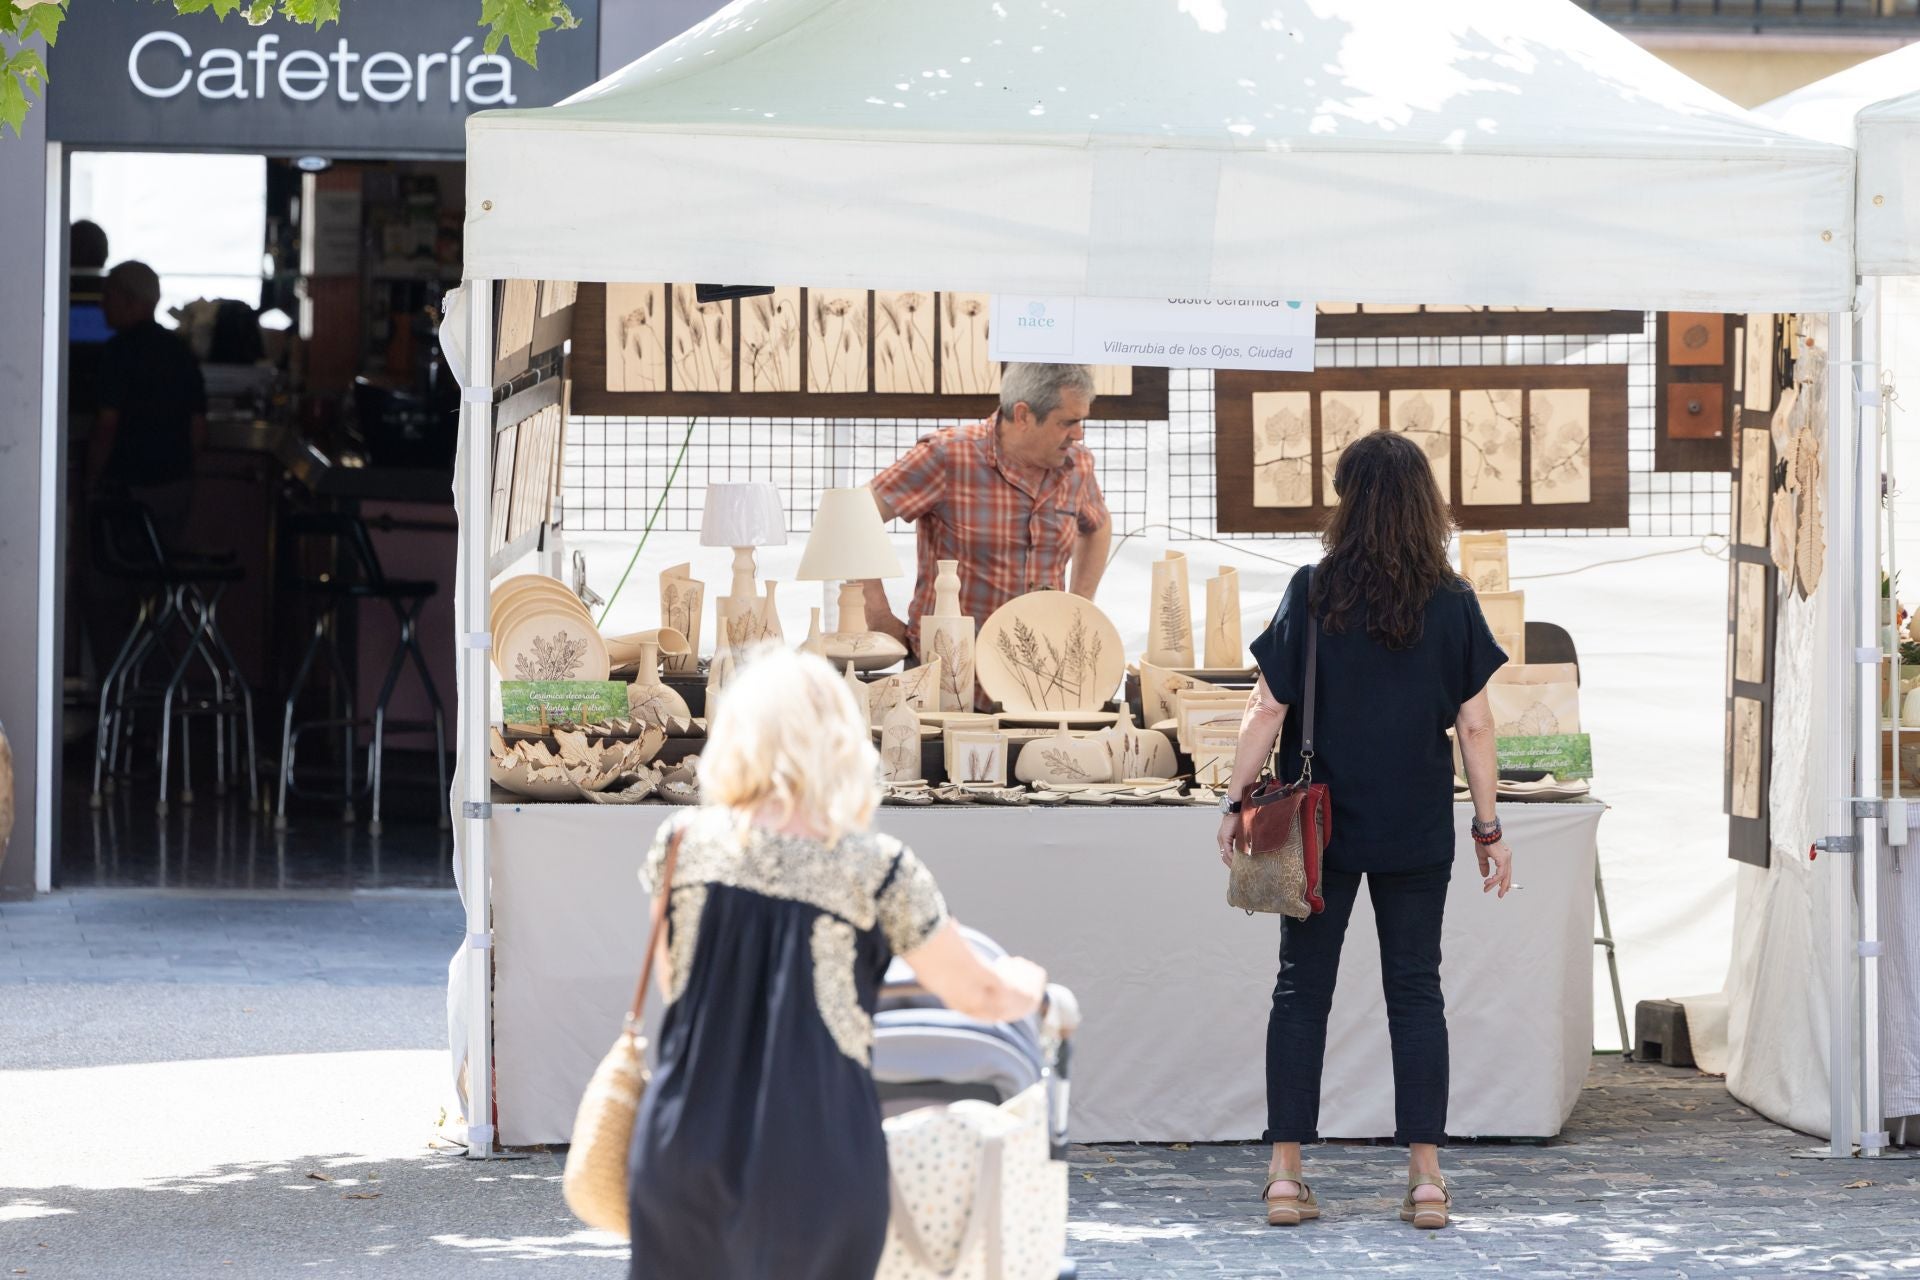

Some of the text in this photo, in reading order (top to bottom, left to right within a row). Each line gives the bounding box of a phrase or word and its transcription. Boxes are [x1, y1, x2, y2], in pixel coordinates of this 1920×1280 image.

[127, 30, 518, 105] Cafetería
[1017, 316, 1055, 328] nace
[1103, 340, 1294, 359] Villarrubia de los Ojos, Ciudad
